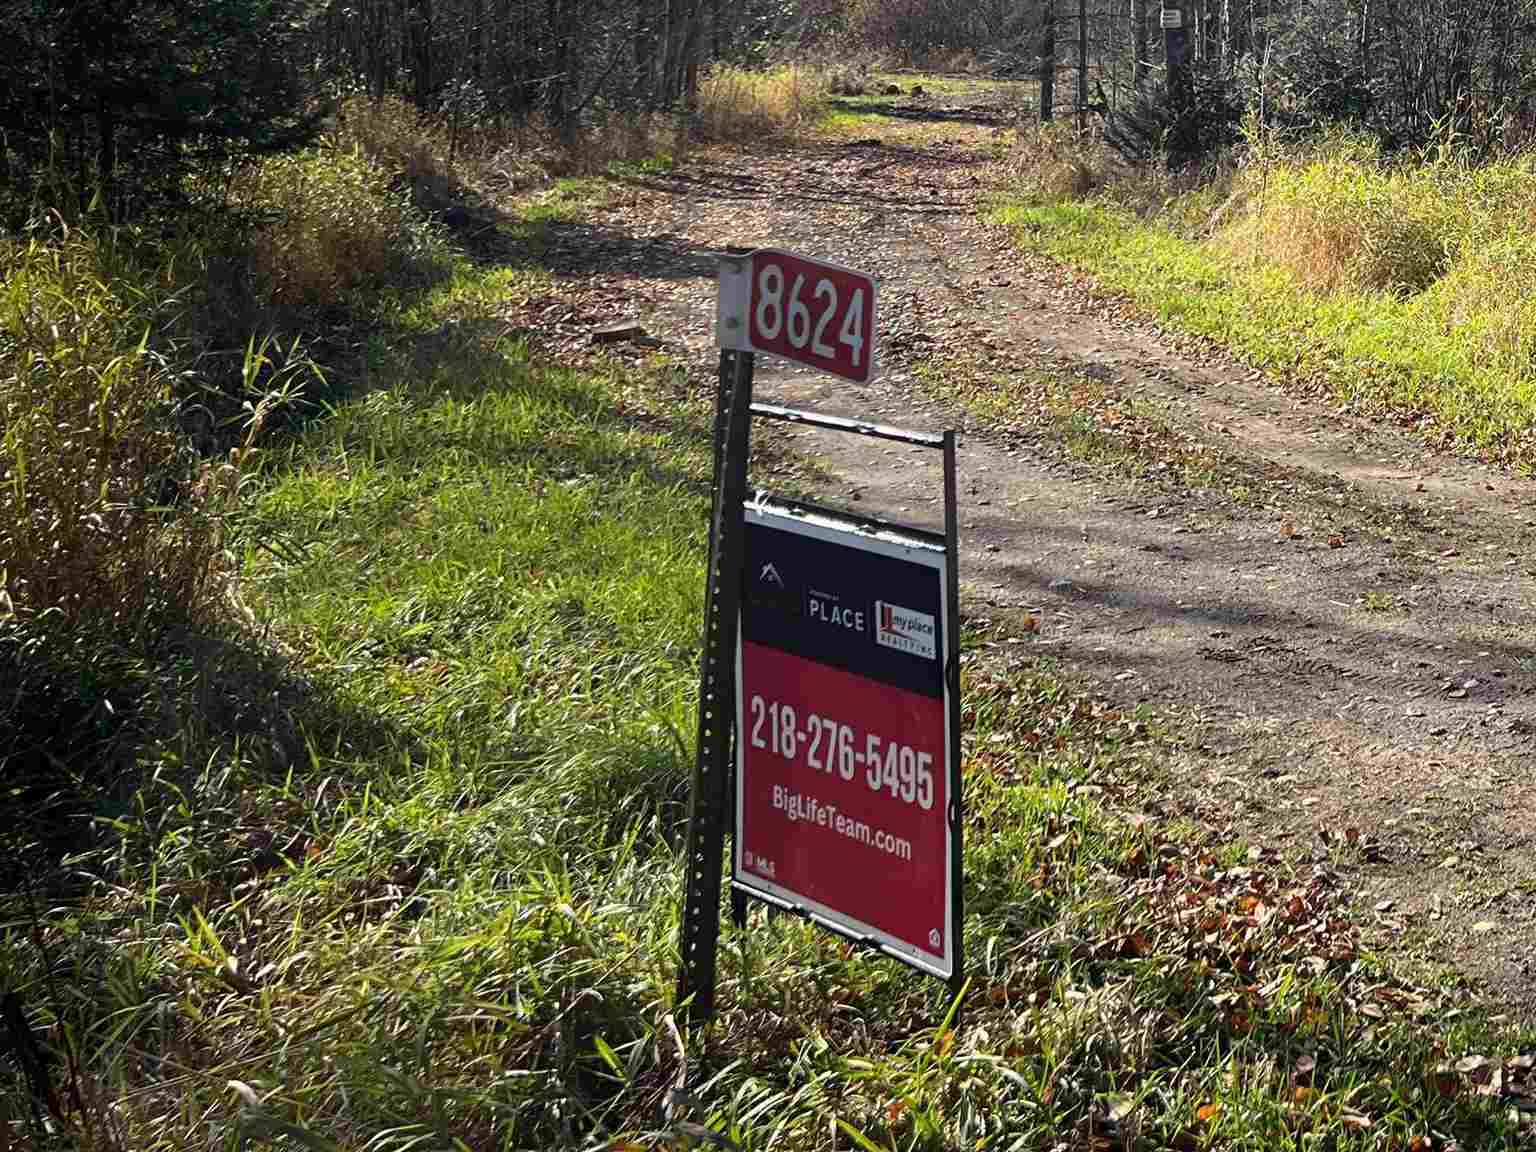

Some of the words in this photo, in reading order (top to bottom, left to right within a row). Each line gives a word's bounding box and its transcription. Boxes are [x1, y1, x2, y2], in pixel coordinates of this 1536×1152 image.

[755, 264, 865, 368] 8624
[810, 599, 865, 632] PLACE
[751, 695, 934, 811] 218-276-5495
[772, 784, 912, 861] BigLifeTeam.com
